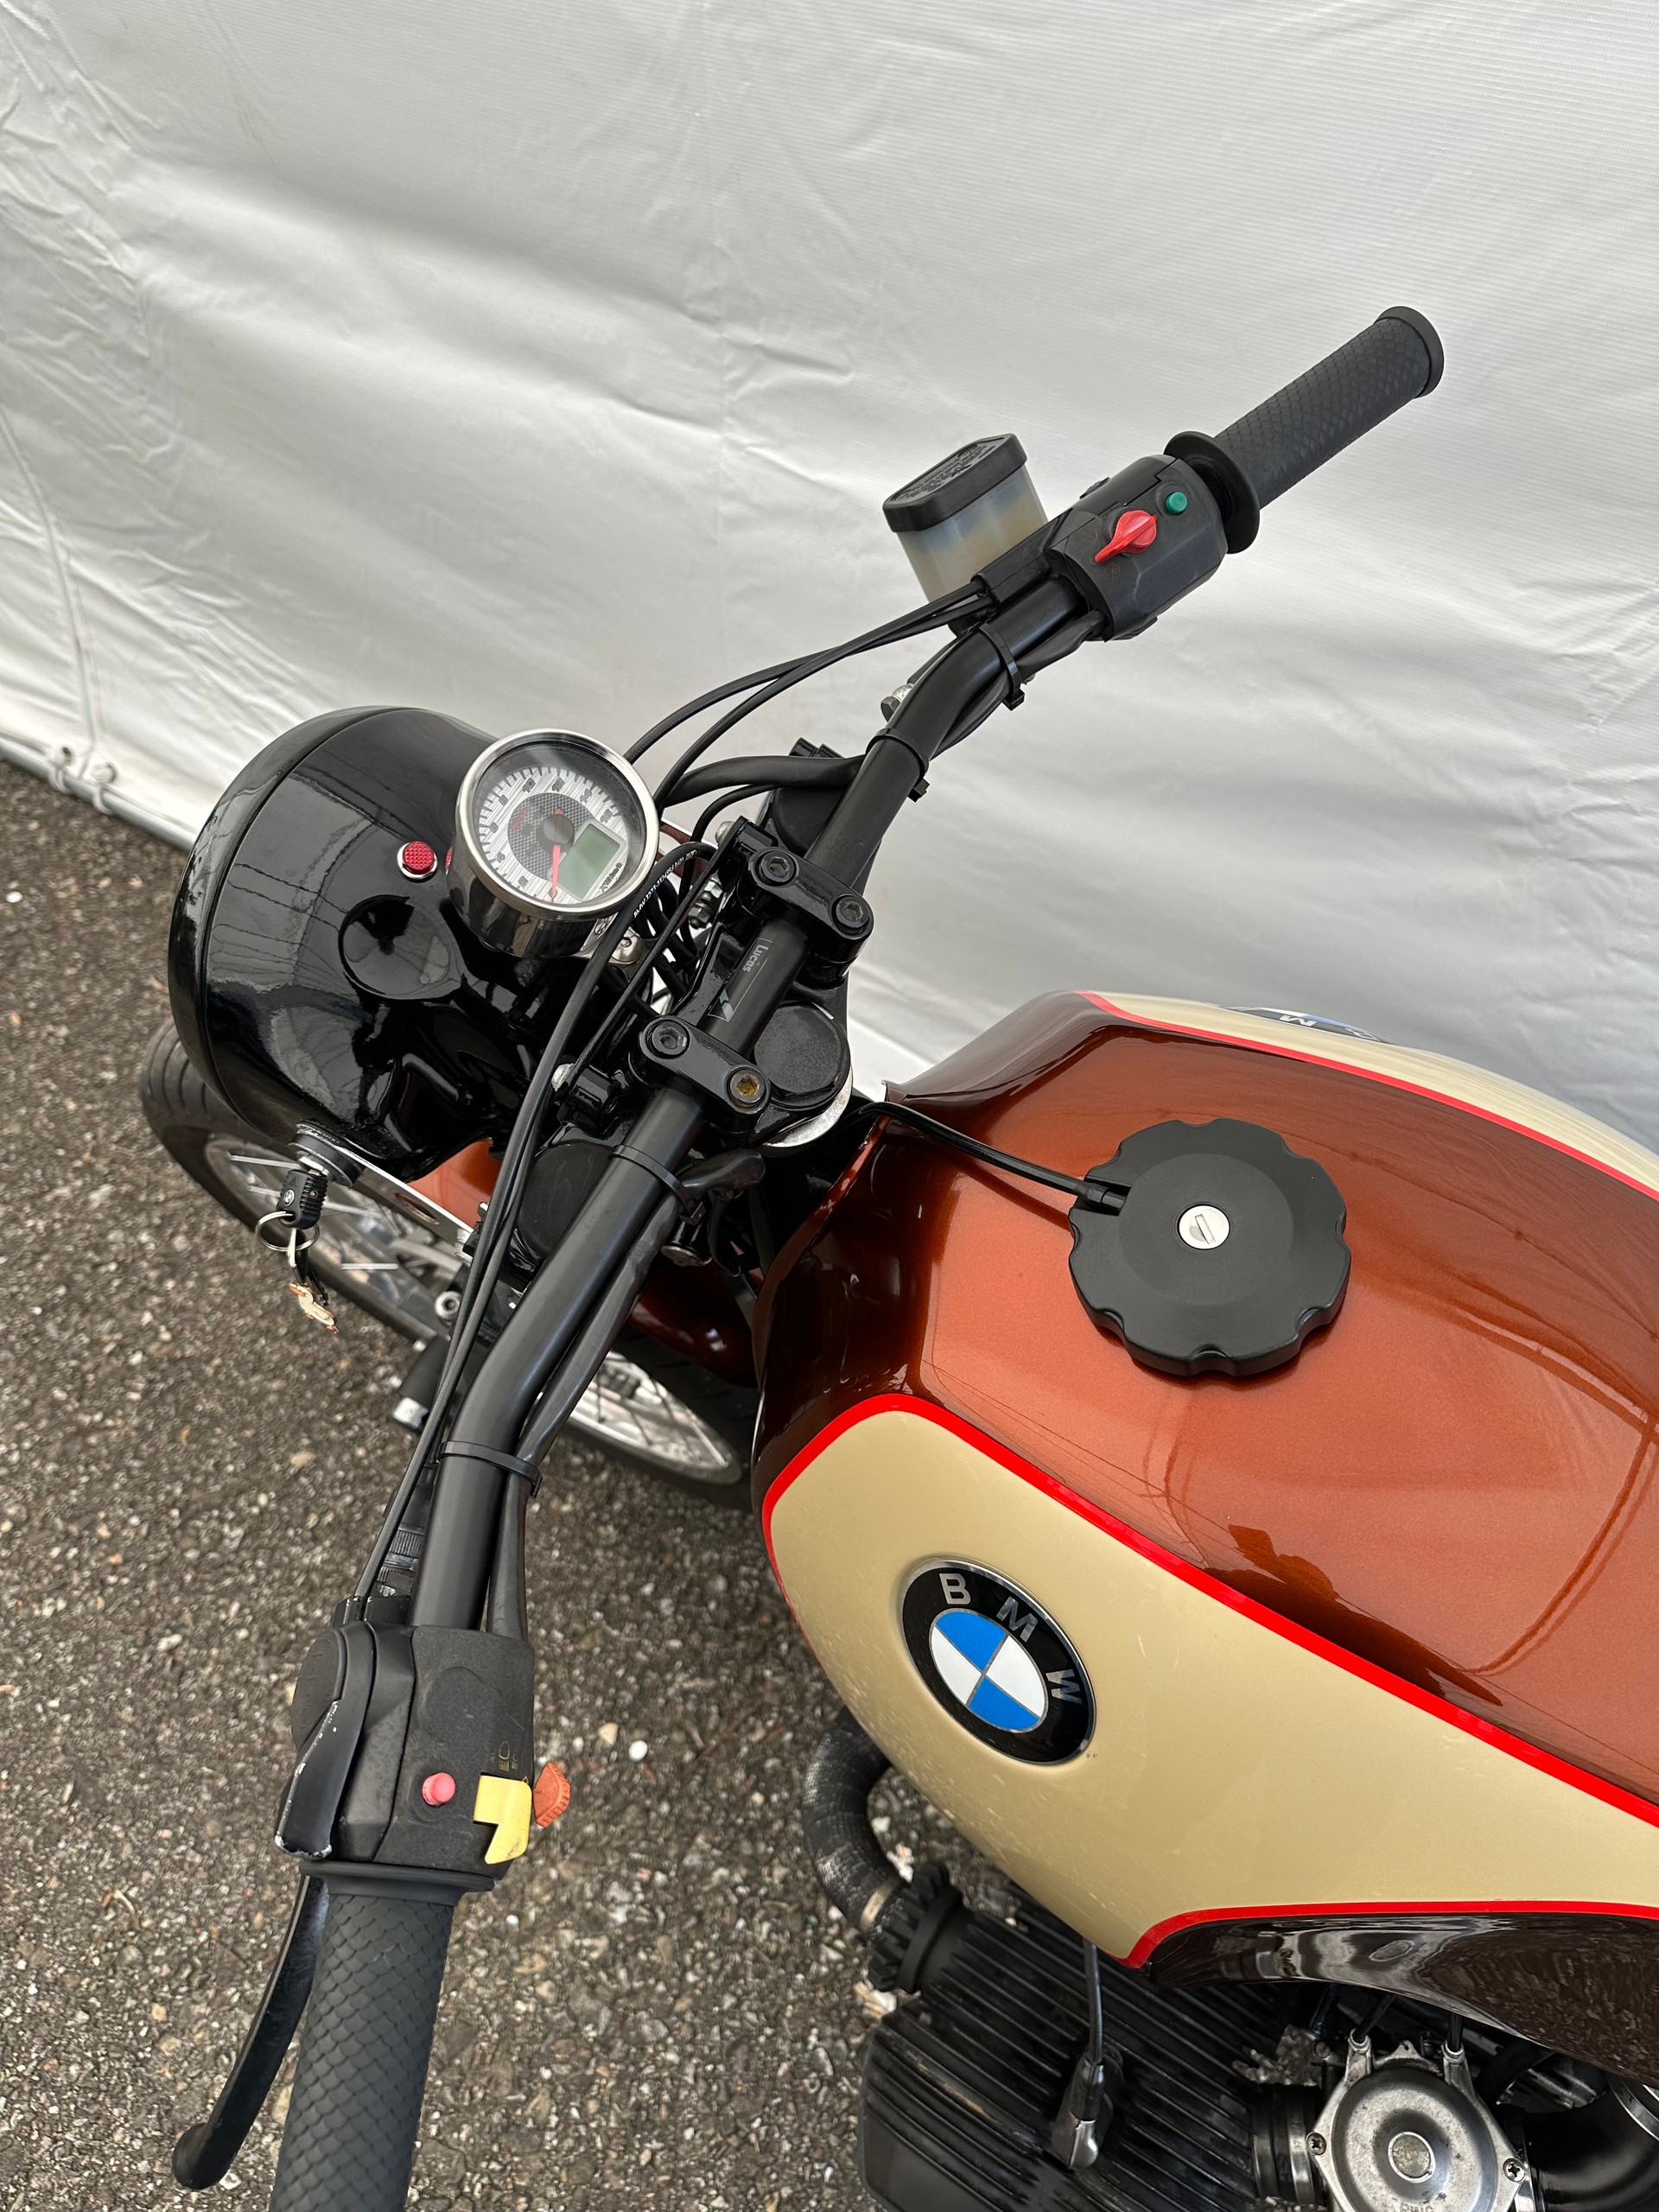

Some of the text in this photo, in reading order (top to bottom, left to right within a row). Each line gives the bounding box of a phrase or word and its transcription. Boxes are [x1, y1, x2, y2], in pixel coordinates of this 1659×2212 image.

[523, 778, 536, 793] 10
[551, 777, 565, 792] 12
[580, 788, 593, 804] 14
[600, 810, 613, 824] 16
[496, 851, 505, 862] 4
[742, 944, 769, 973] Lucas
[939, 1573, 1083, 1705] BMW
